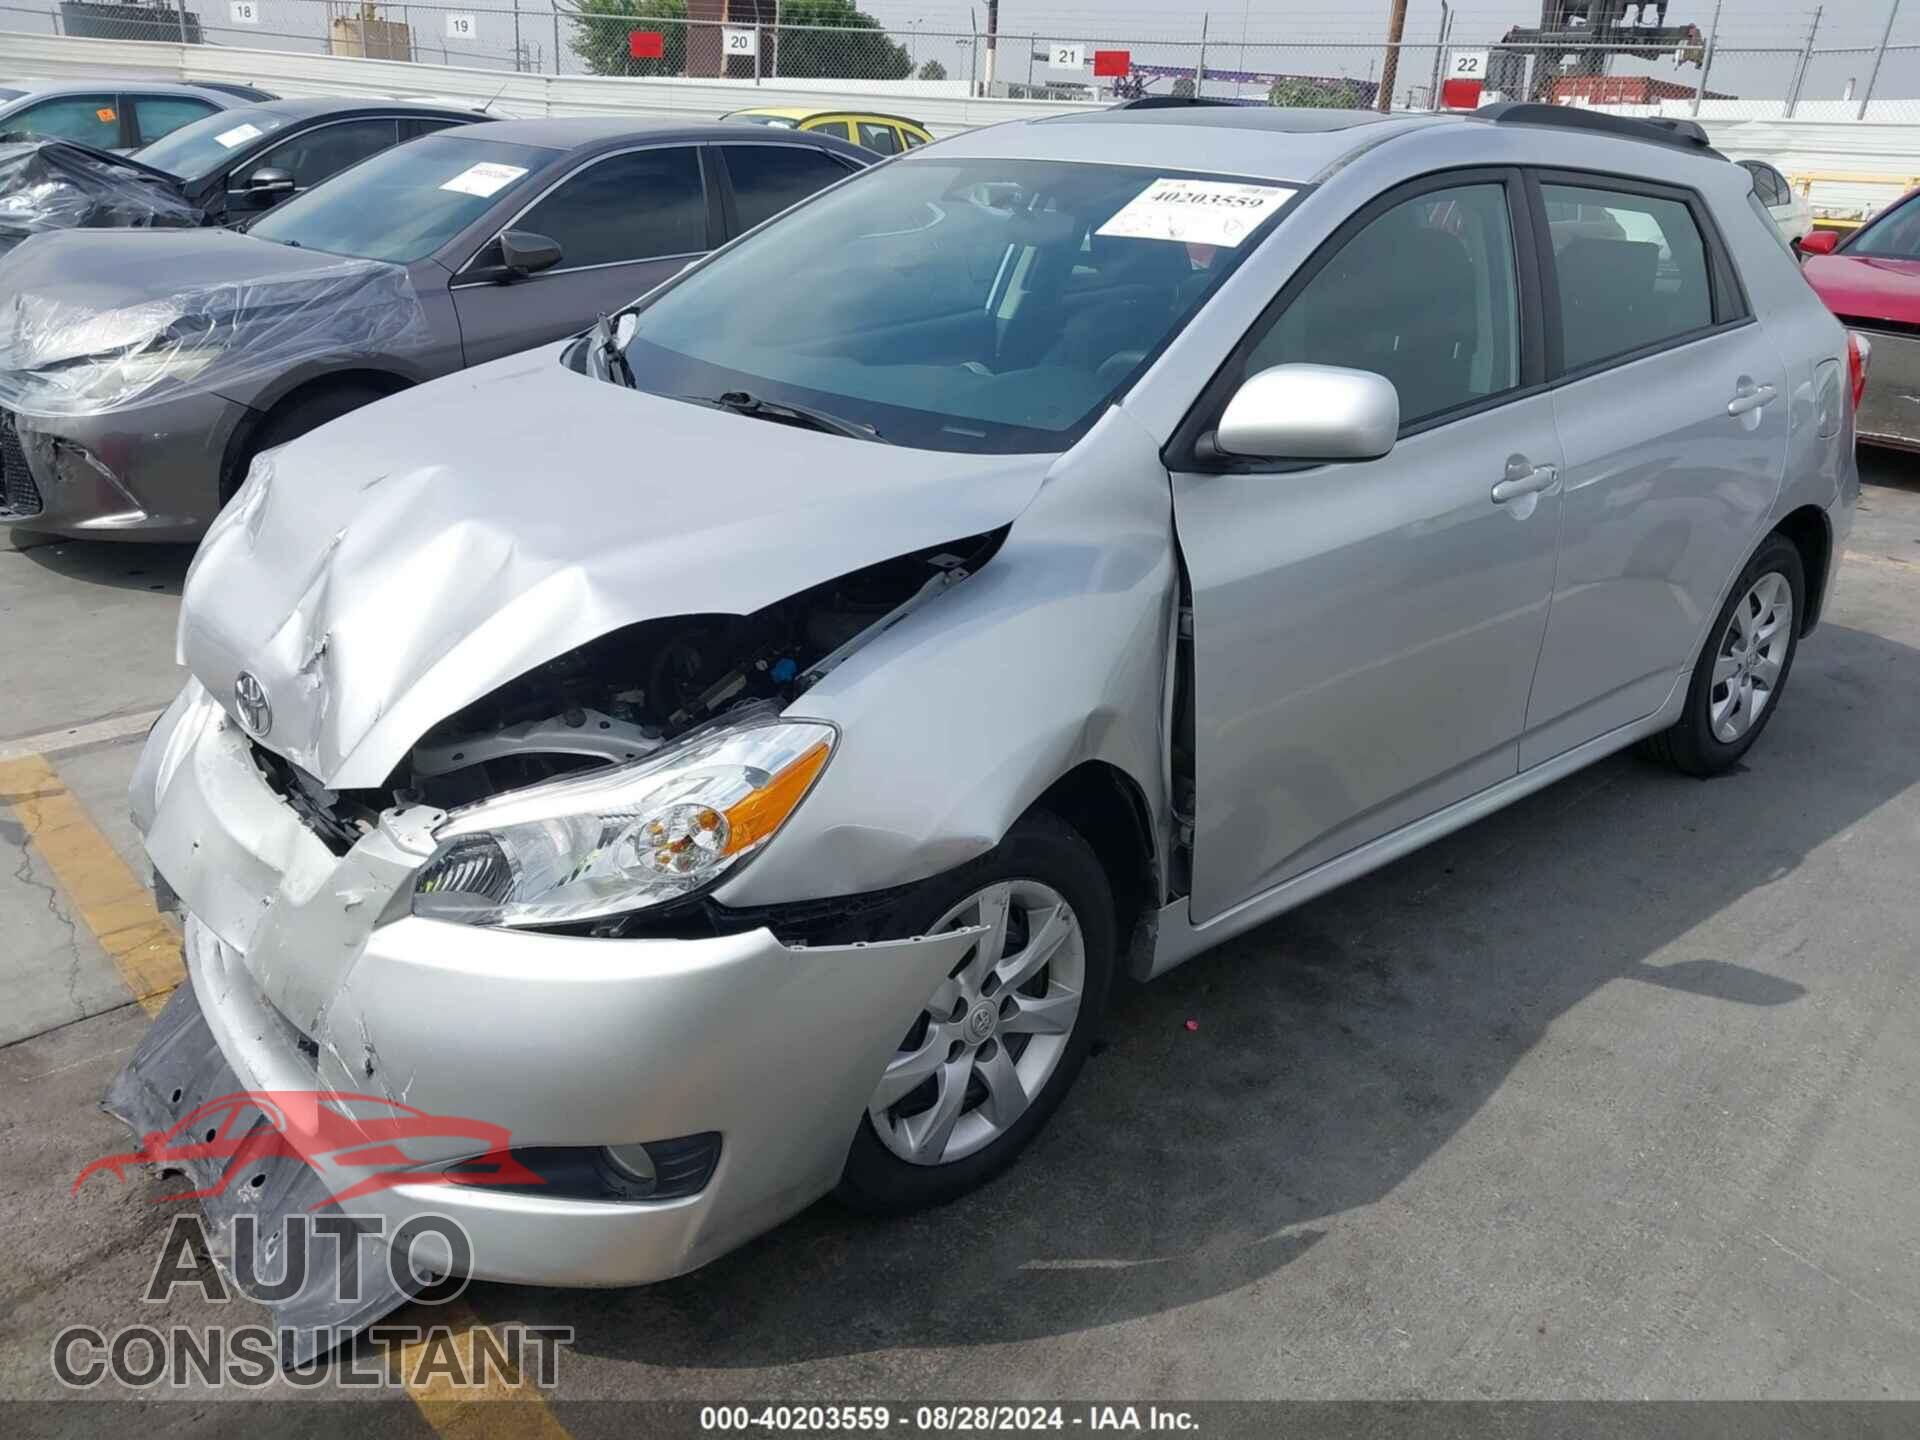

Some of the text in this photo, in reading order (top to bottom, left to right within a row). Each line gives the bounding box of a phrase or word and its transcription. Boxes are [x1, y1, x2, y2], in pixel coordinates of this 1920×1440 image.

[238, 6, 251, 18] 18
[454, 20, 468, 32] 19
[731, 36, 748, 48] 20
[1058, 50, 1075, 63] 21
[1457, 58, 1478, 72] 22
[1151, 190, 1265, 209] 40203559
